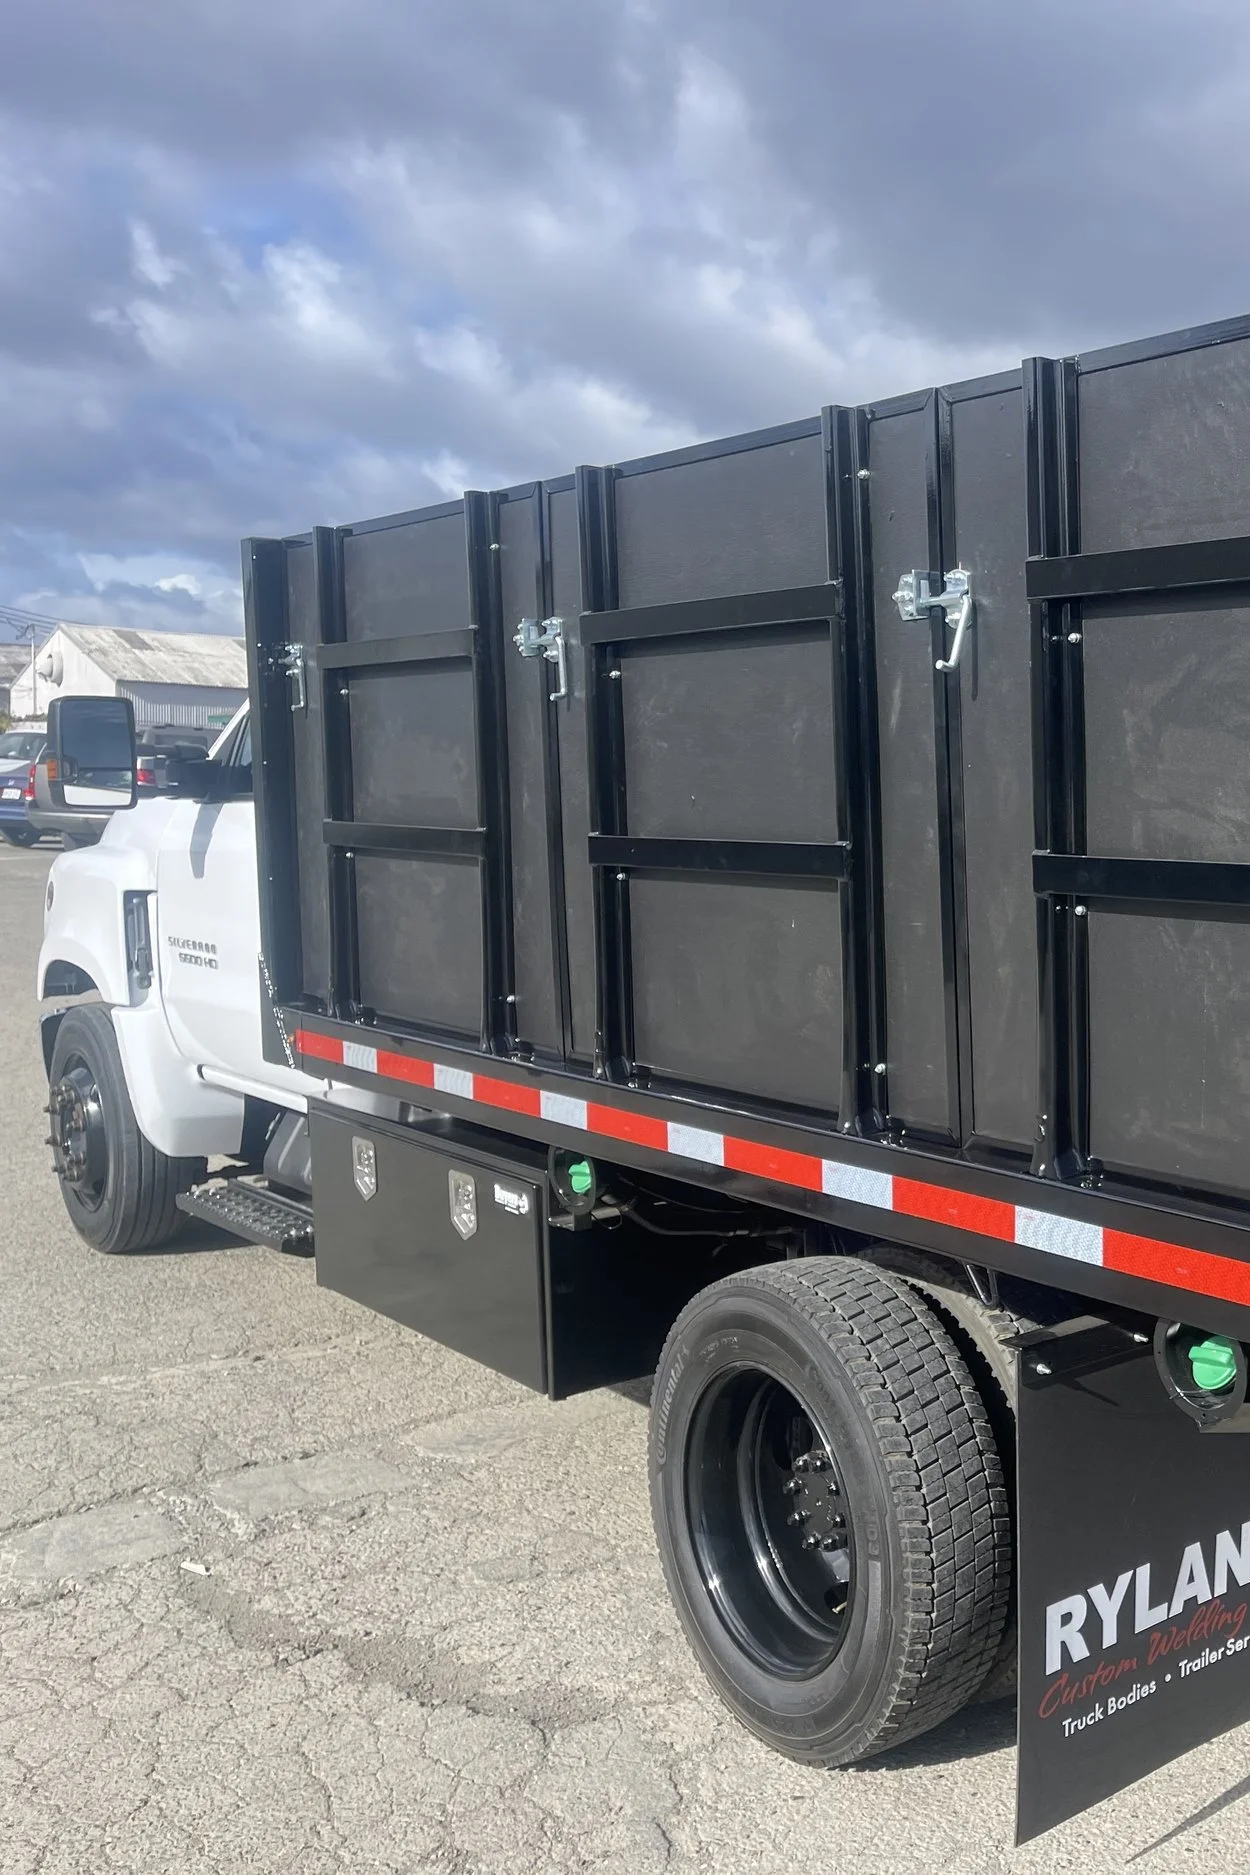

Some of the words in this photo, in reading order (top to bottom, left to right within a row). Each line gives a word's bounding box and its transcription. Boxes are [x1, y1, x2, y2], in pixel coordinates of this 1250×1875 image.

[1039, 1656, 1138, 1719] Custom
[1147, 1599, 1248, 1667] Welding
[1062, 1703, 1104, 1738] Truck
[1107, 1679, 1157, 1716] Bodies
[1178, 1648, 1225, 1678] Trailer
